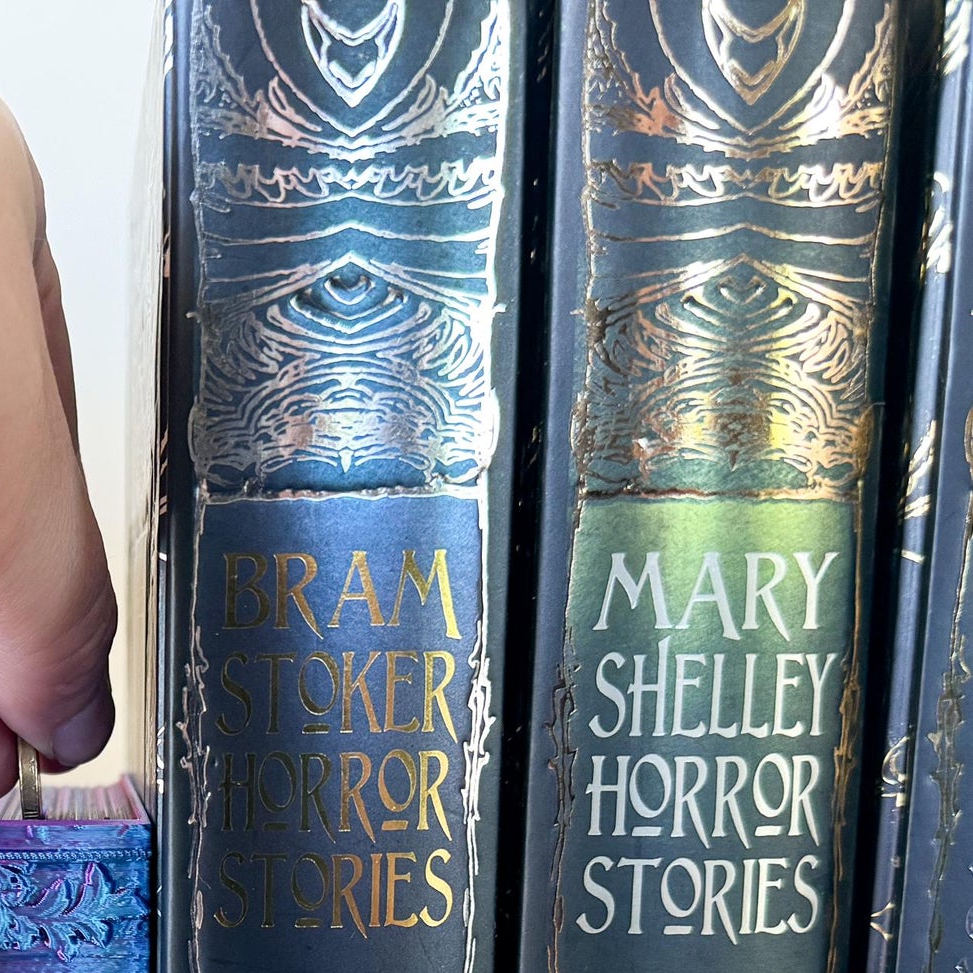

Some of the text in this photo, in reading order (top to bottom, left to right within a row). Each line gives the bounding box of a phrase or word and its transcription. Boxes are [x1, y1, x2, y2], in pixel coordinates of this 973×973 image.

[221, 549, 462, 640] BRAM
[592, 551, 840, 641] MARY
[214, 650, 458, 744] STOKER
[588, 637, 838, 738] SHELLEY
[218, 748, 452, 843] HORROR
[585, 753, 820, 849] HORROR
[213, 848, 454, 939] STORIES
[576, 854, 819, 945] STORIES
